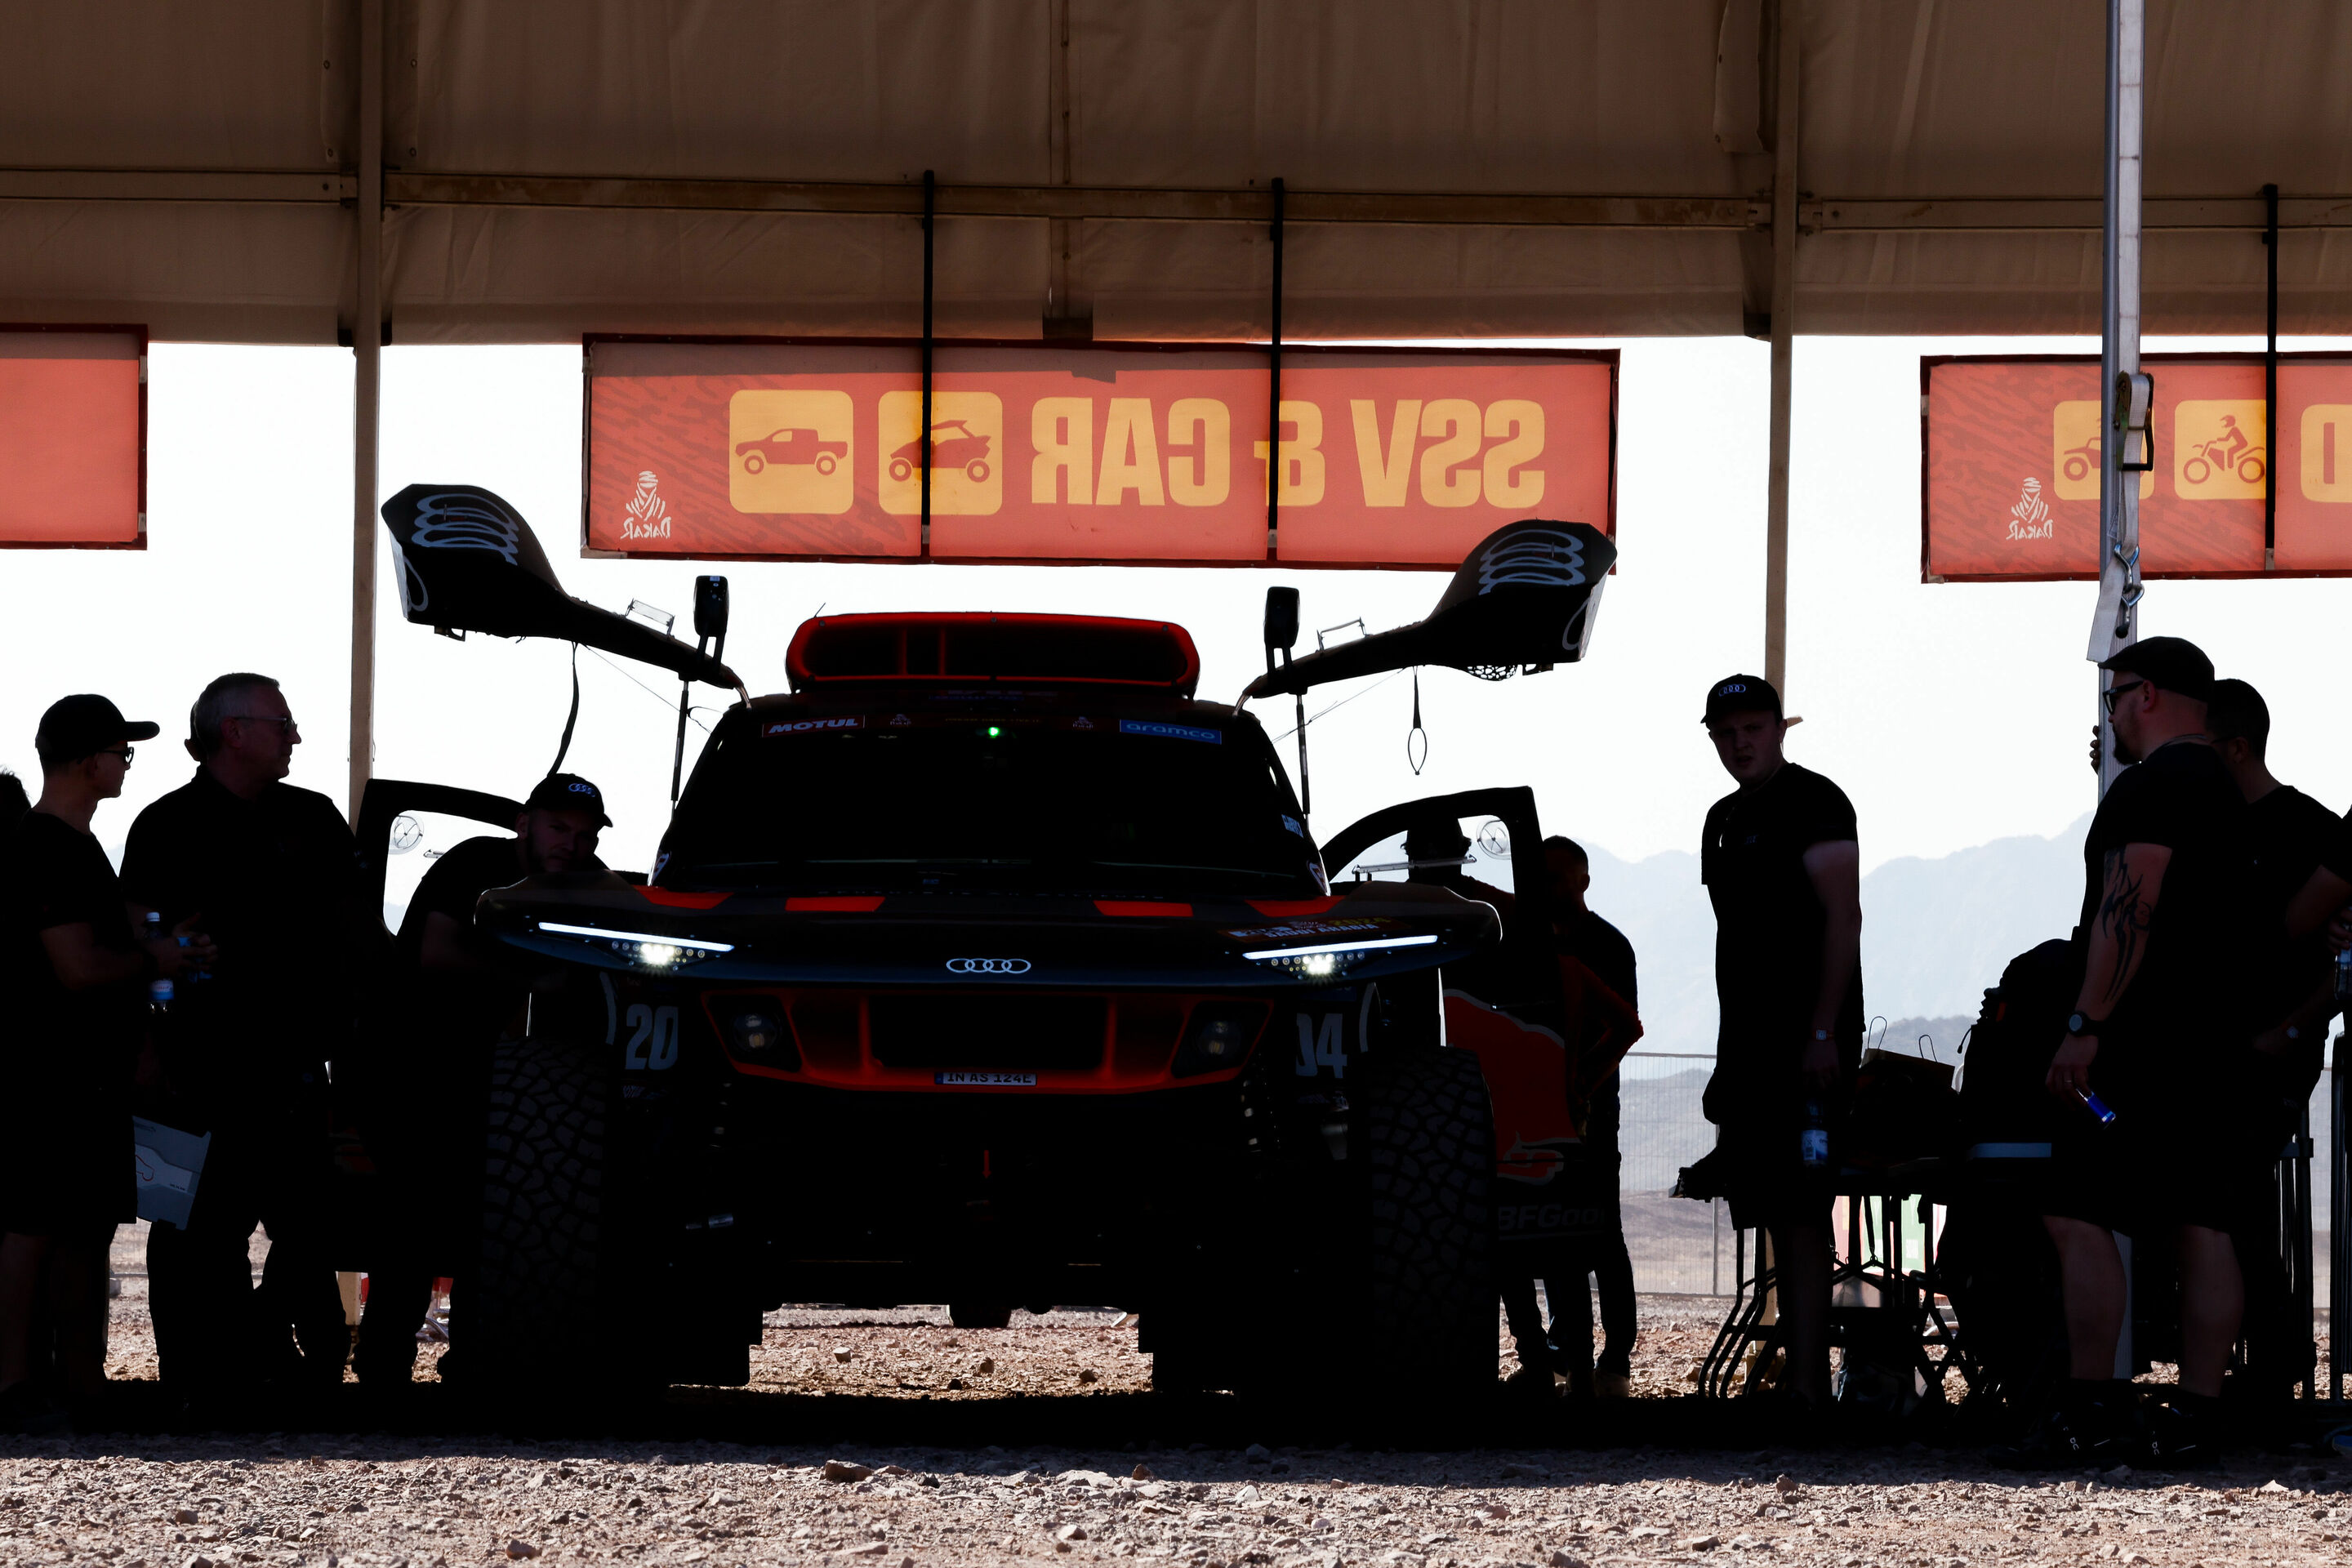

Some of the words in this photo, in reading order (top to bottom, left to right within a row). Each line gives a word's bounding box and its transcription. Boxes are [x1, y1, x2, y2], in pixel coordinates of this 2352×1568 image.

[768, 717, 859, 734] MOTUL
[1125, 722, 1216, 739] aramco
[624, 1003, 679, 1071] 20
[947, 1072, 965, 1082] IN
[969, 1073, 989, 1083] AS
